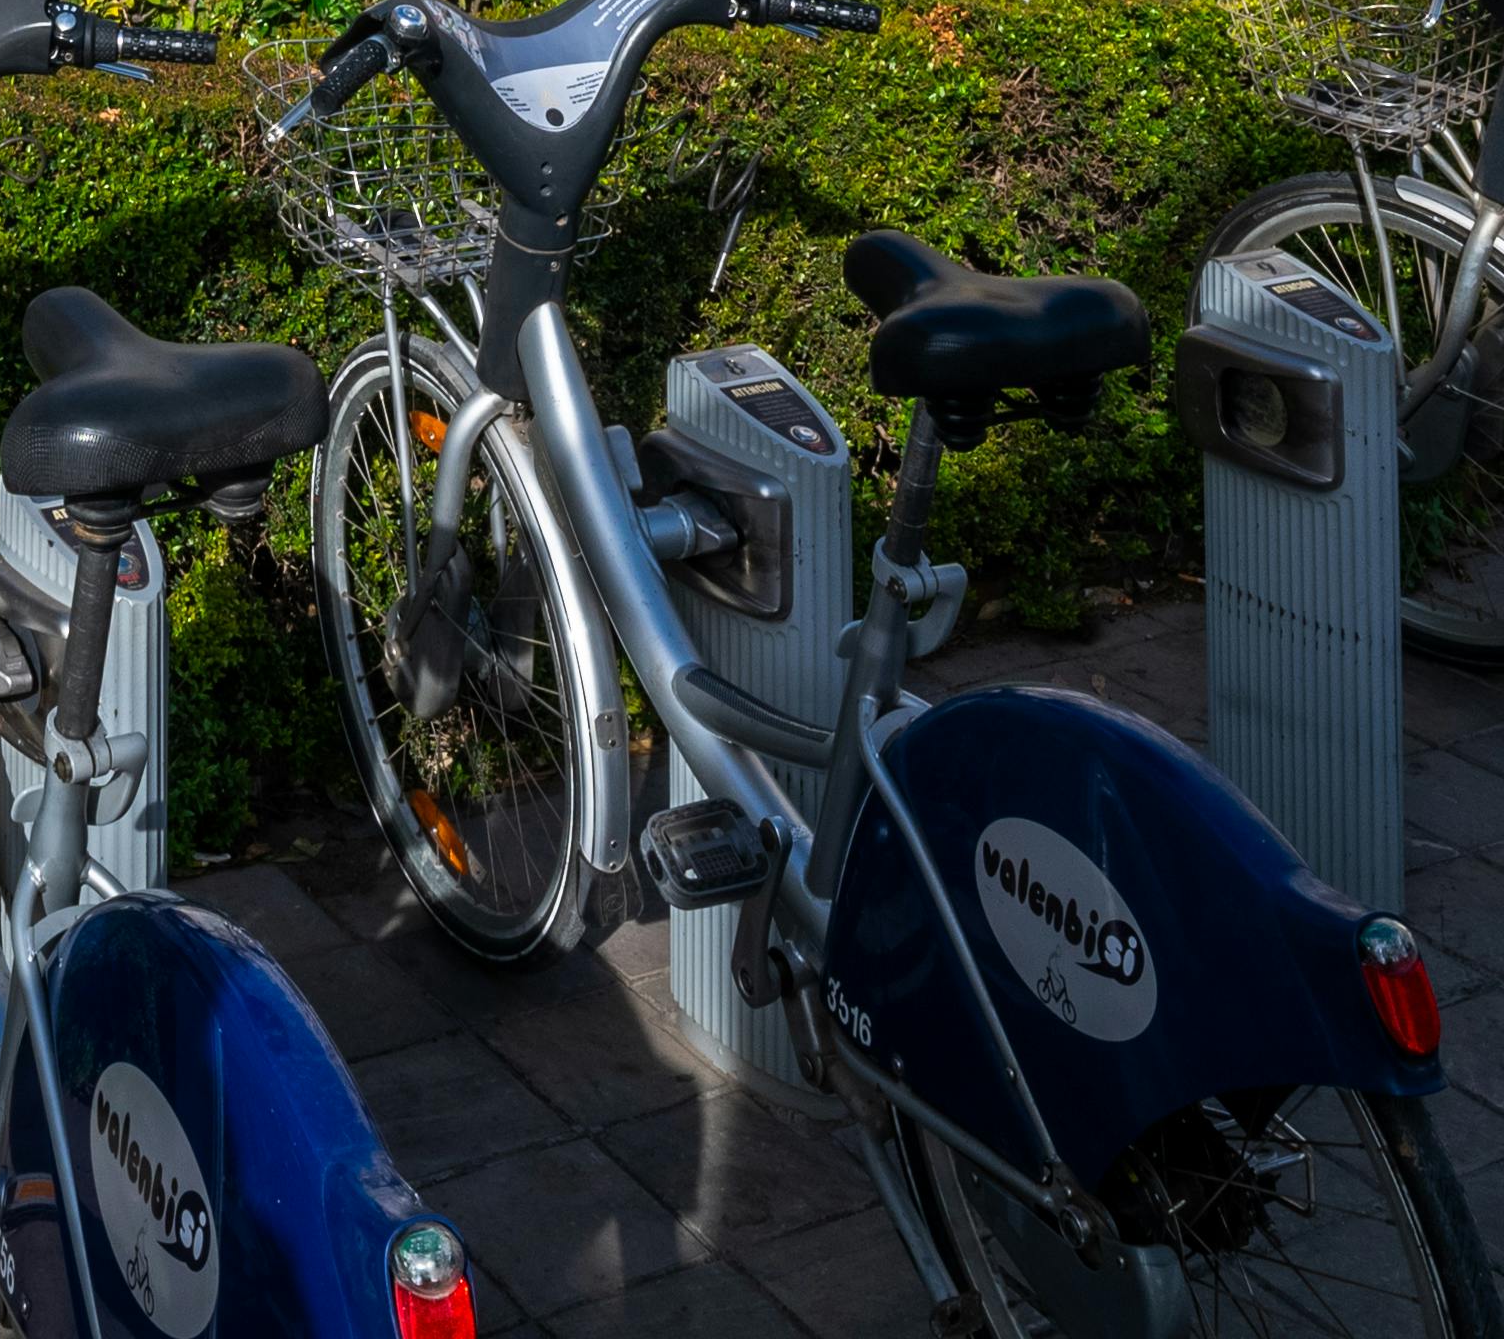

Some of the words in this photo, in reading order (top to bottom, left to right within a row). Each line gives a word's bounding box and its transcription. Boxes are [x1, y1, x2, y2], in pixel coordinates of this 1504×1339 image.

[1256, 261, 1278, 276] 9
[983, 840, 1140, 979] valenbisi
[827, 976, 872, 1047] 3516
[97, 1089, 209, 1265] valenbisi
